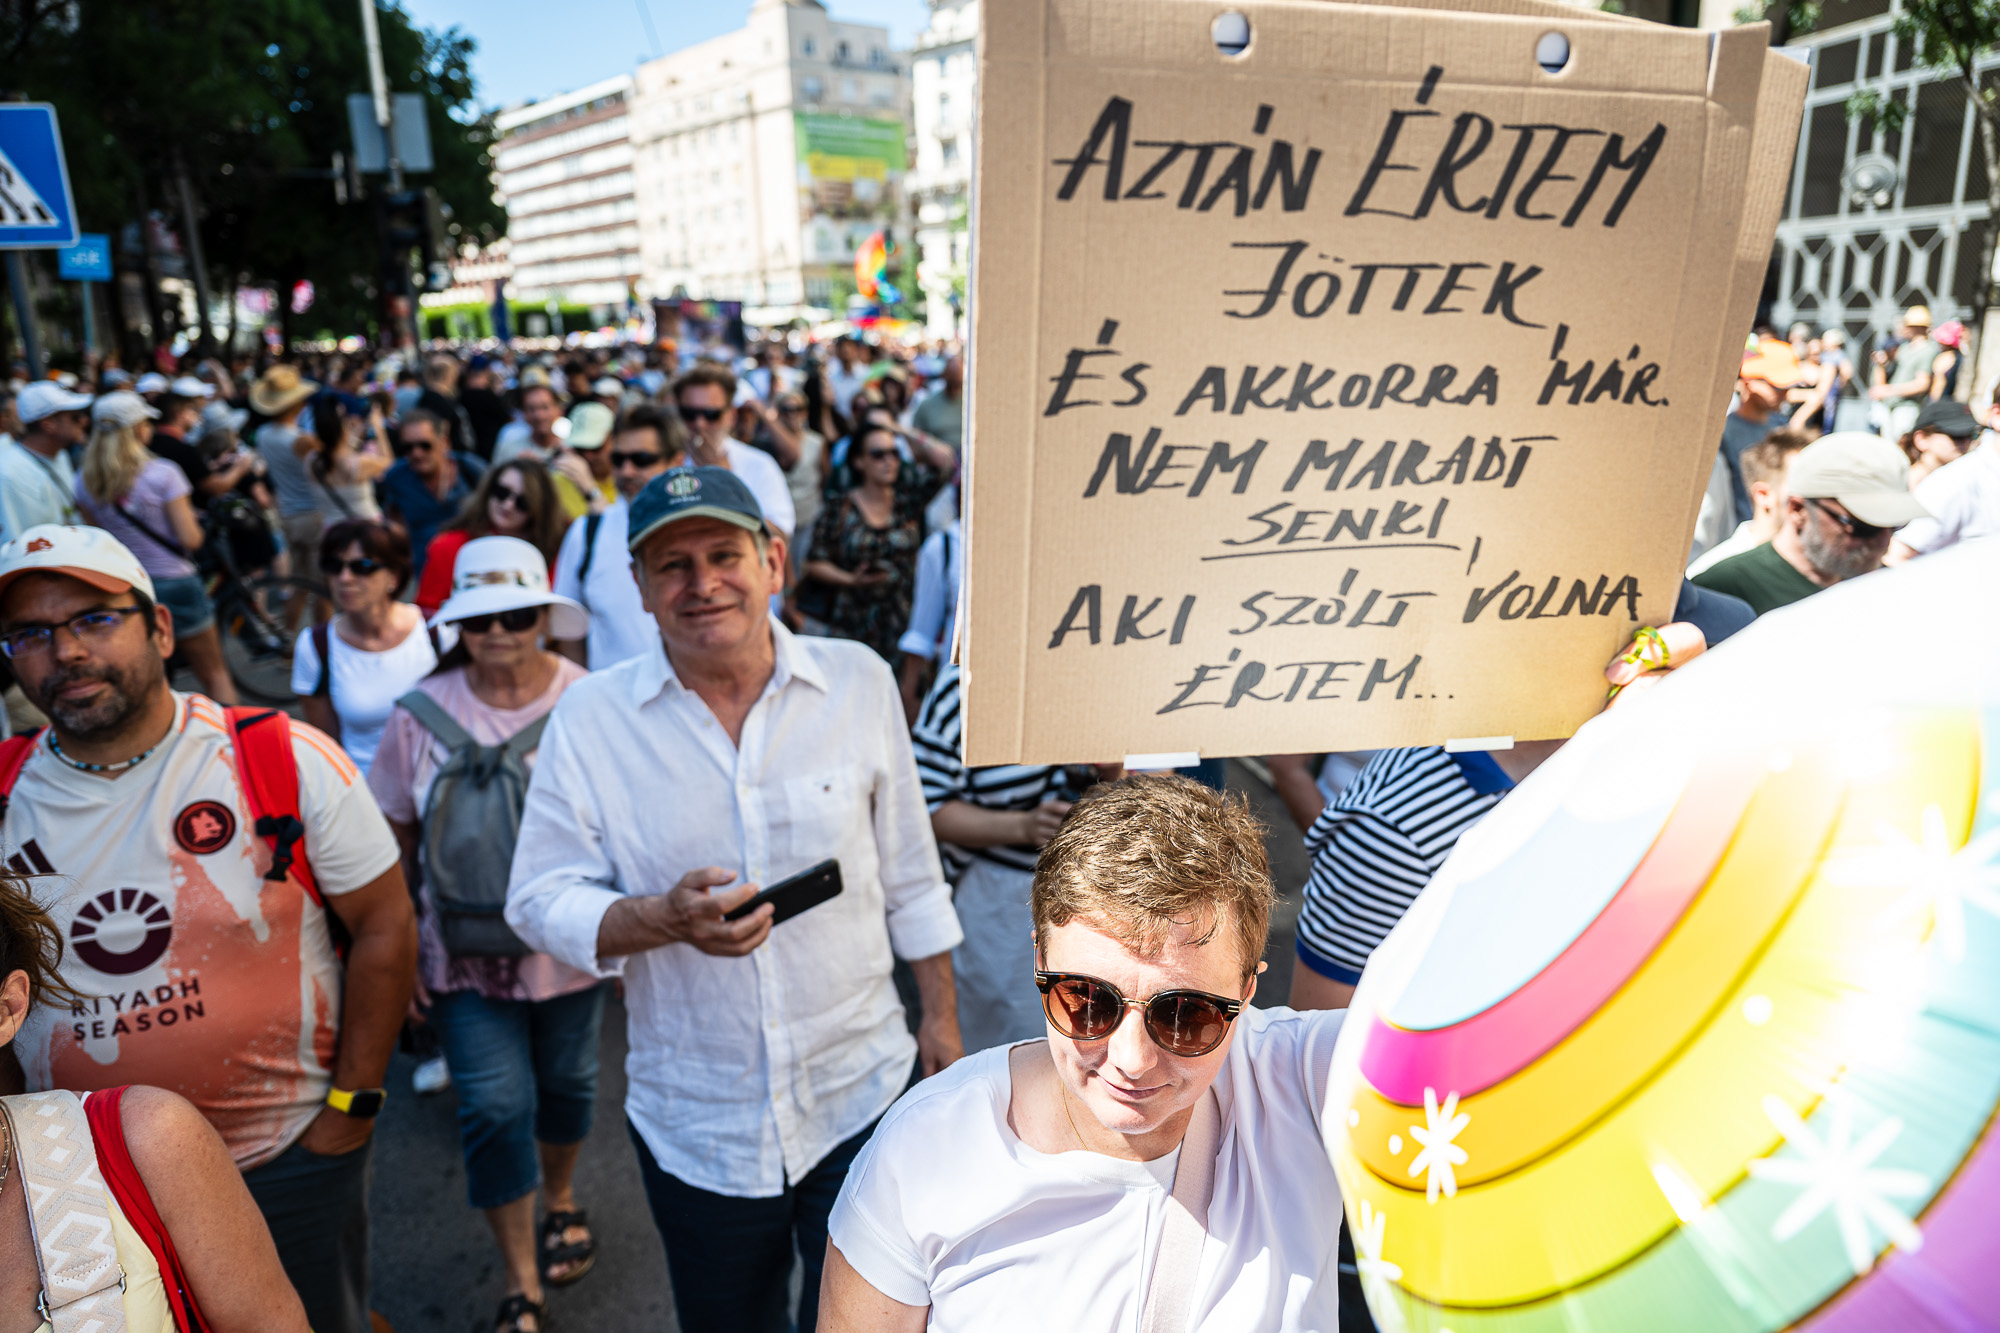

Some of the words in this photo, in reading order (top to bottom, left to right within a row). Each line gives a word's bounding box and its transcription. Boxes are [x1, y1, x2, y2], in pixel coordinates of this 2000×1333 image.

[1052, 95, 1323, 218] AZTÁN
[1343, 65, 1668, 229] ÉRTEM
[1043, 318, 1152, 417] ÉS
[1174, 362, 1499, 416] AKKORRA
[1537, 343, 1671, 408] MÁR.
[1083, 427, 1268, 498] NEM
[1282, 435, 1557, 492] MARADT
[1048, 584, 1196, 649] AKI
[1229, 568, 1437, 636] SZÓLT
[1462, 569, 1643, 623] VOLNA
[1156, 648, 1456, 715] ÉRTEM...
[71, 977, 201, 1018] RIYADH
[73, 1001, 206, 1041] SEASON
